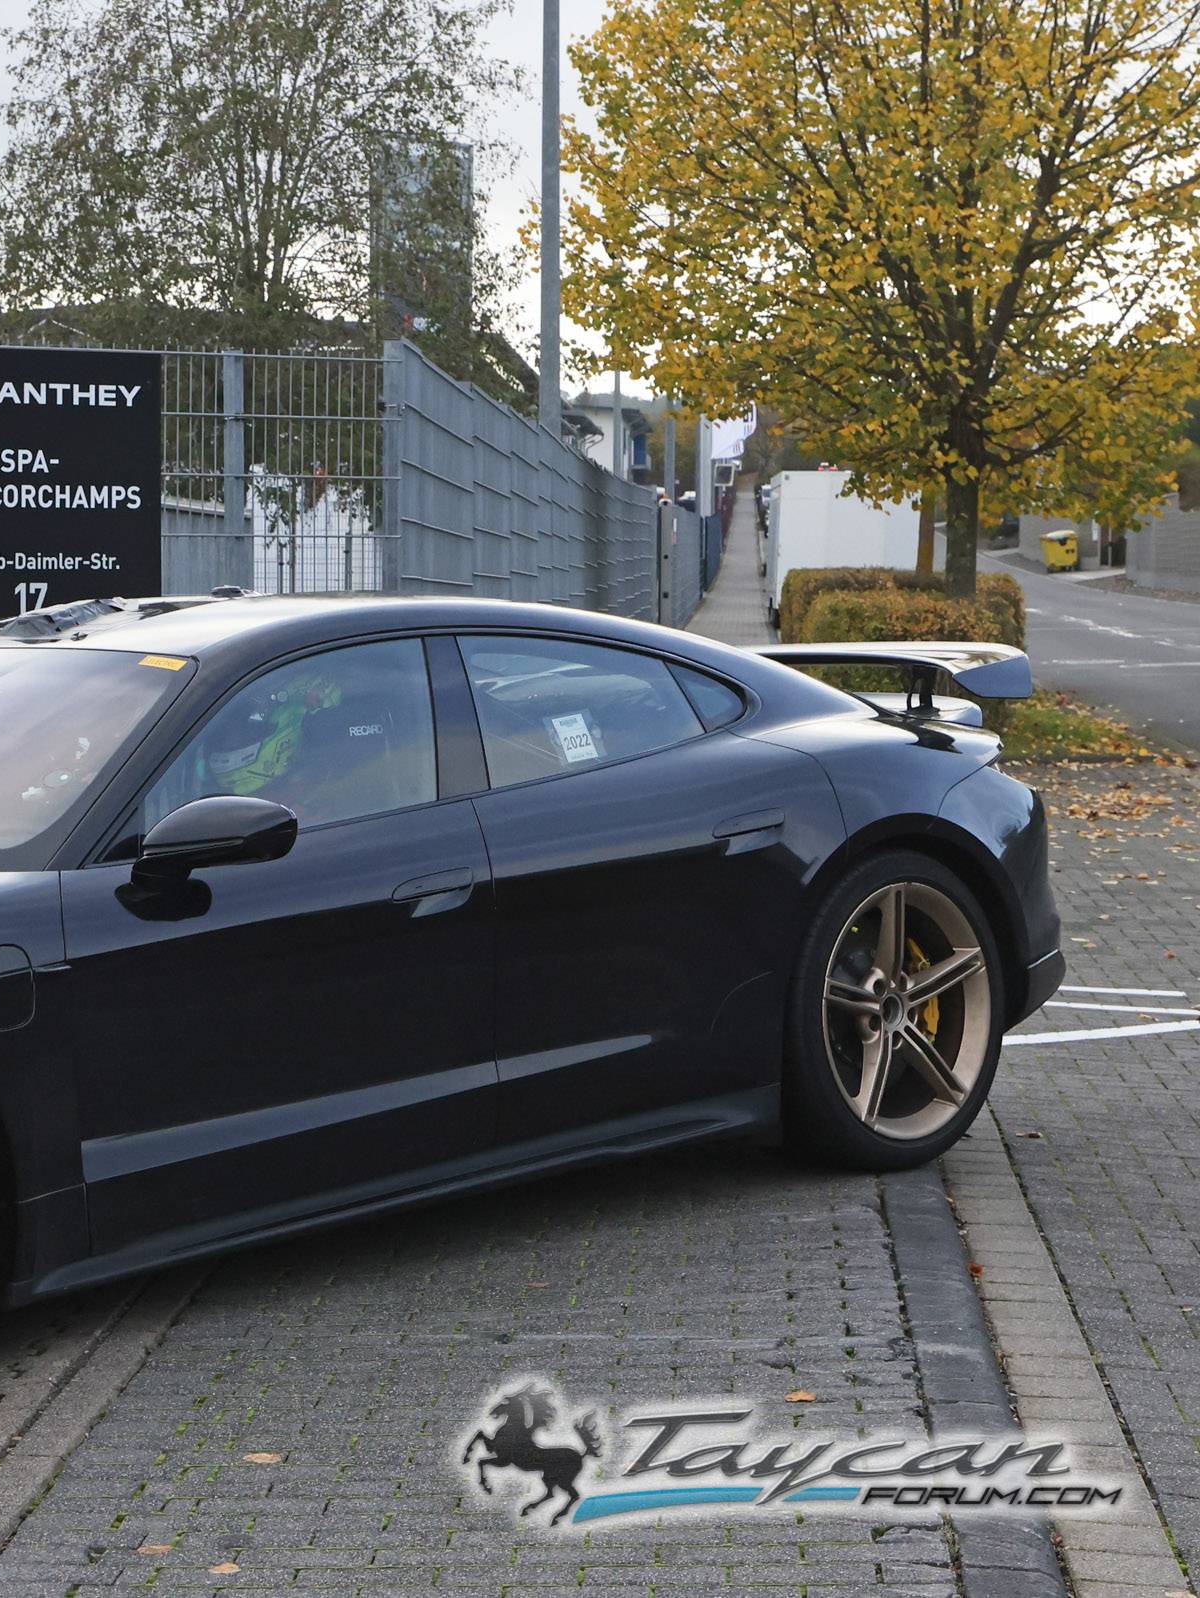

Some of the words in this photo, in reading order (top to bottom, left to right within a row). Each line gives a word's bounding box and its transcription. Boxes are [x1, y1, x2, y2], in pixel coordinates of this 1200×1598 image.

[0, 448, 60, 474] SPA-
[14, 582, 48, 616] 17
[563, 733, 591, 751] 2022
